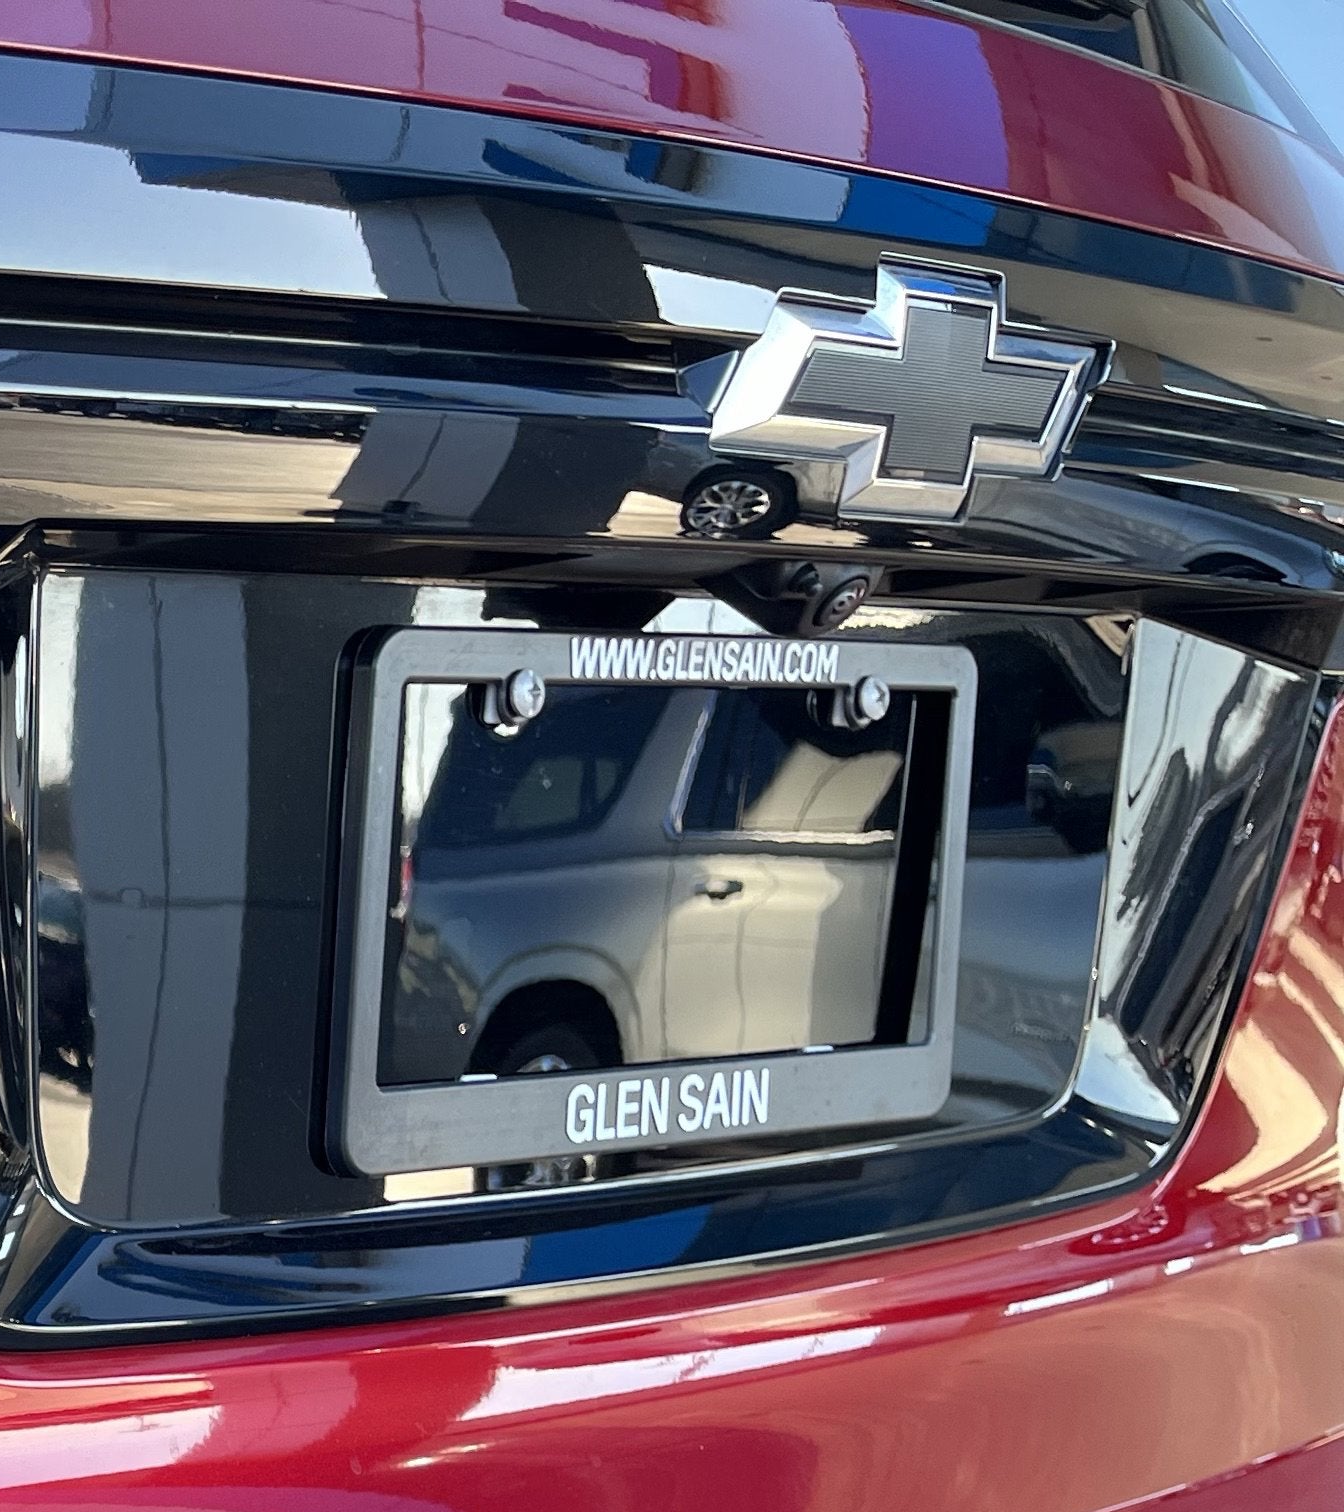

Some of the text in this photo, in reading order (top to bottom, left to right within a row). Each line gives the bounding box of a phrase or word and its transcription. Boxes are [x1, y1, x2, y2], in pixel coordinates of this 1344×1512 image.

[570, 636, 839, 682] WWW.GLENSAIN.COM
[566, 1068, 770, 1144] GLEN SAIN
